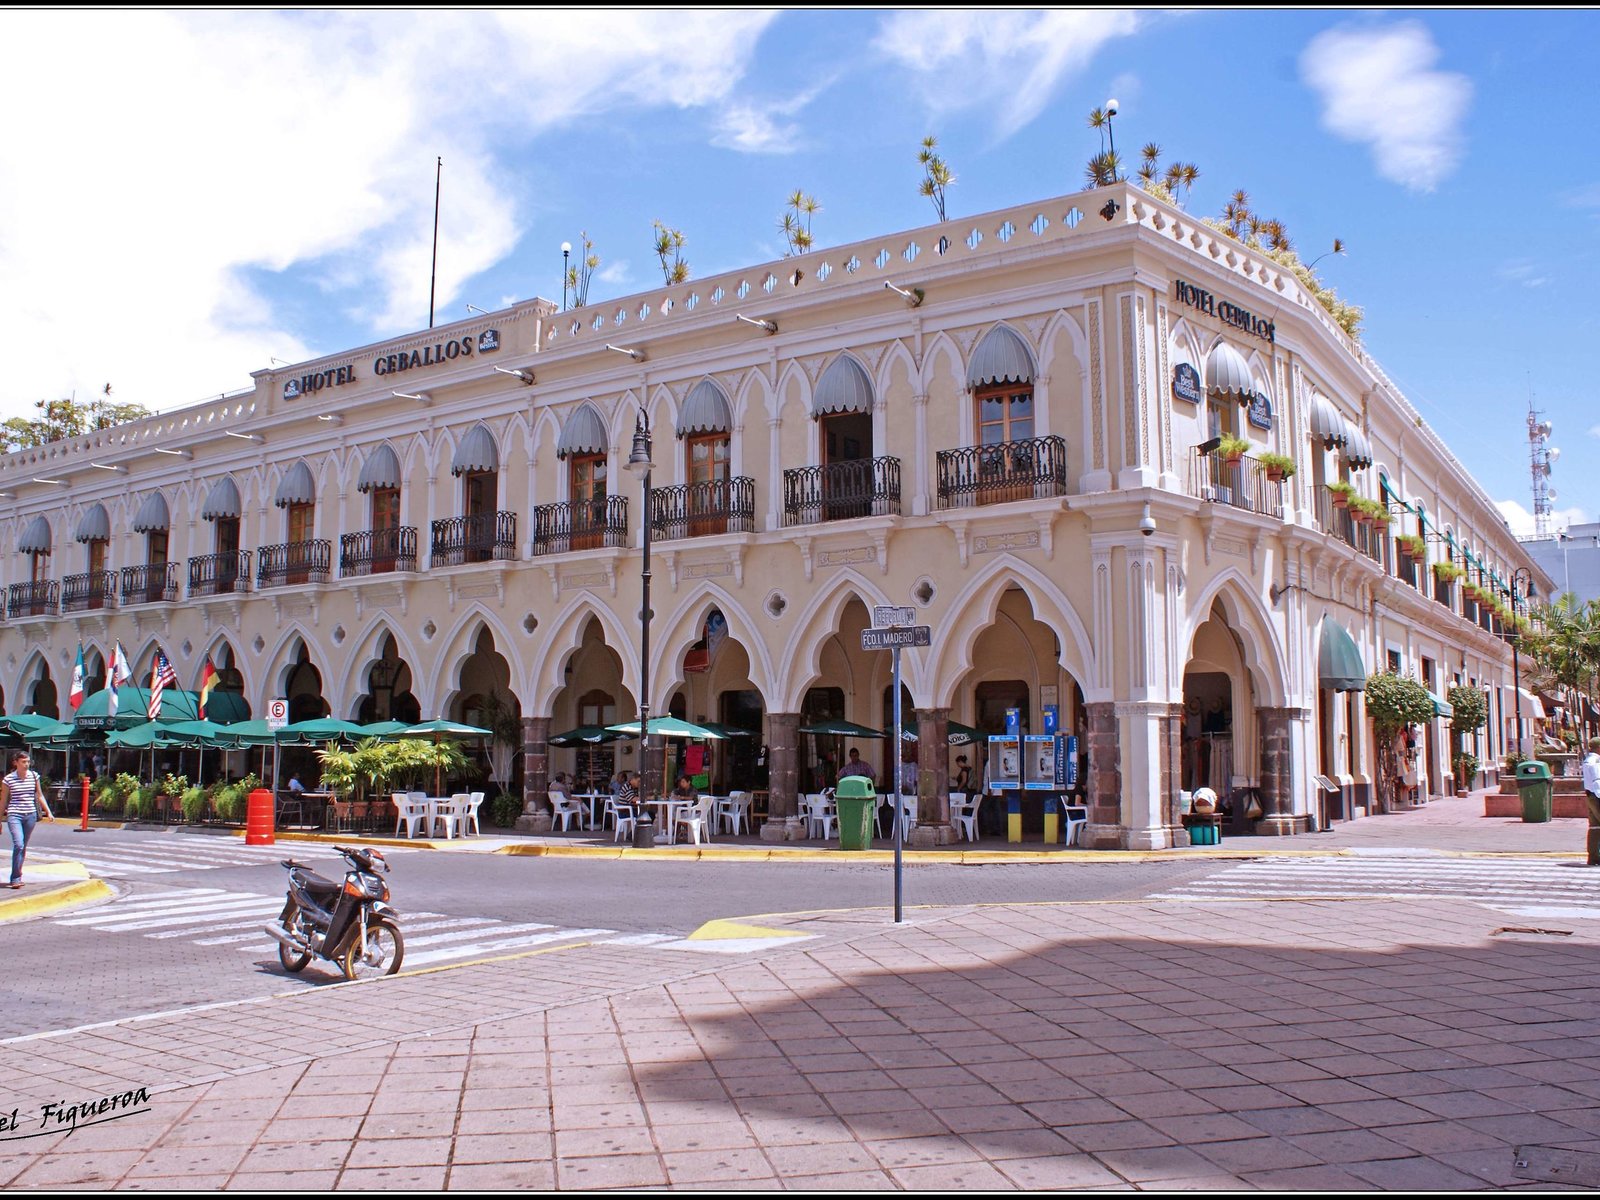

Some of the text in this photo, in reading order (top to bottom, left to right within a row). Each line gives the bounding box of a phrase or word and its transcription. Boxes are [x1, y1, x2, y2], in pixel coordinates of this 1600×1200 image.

[1175, 279, 1276, 344] HOTEL CEBALLOS
[300, 336, 473, 394] HOTEL CEBALLOS
[1180, 374, 1195, 389] Best
[883, 631, 913, 645] MADERO
